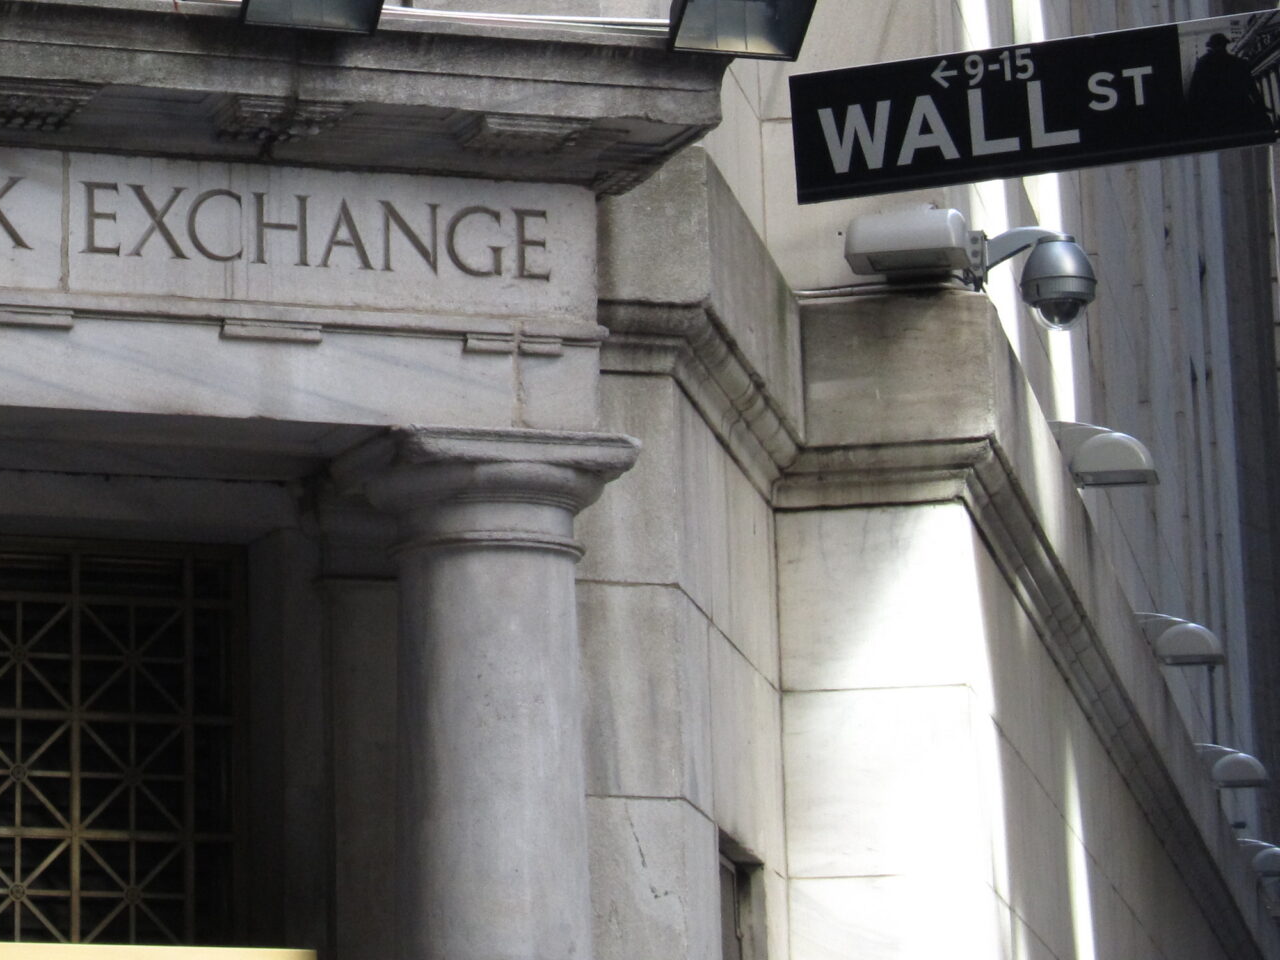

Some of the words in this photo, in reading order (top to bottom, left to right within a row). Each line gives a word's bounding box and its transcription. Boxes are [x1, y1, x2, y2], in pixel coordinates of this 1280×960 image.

[964, 48, 1036, 86] 9-15
[818, 80, 1081, 174] WALL
[1087, 66, 1154, 111] ST
[78, 180, 553, 282] EXCHANGE
